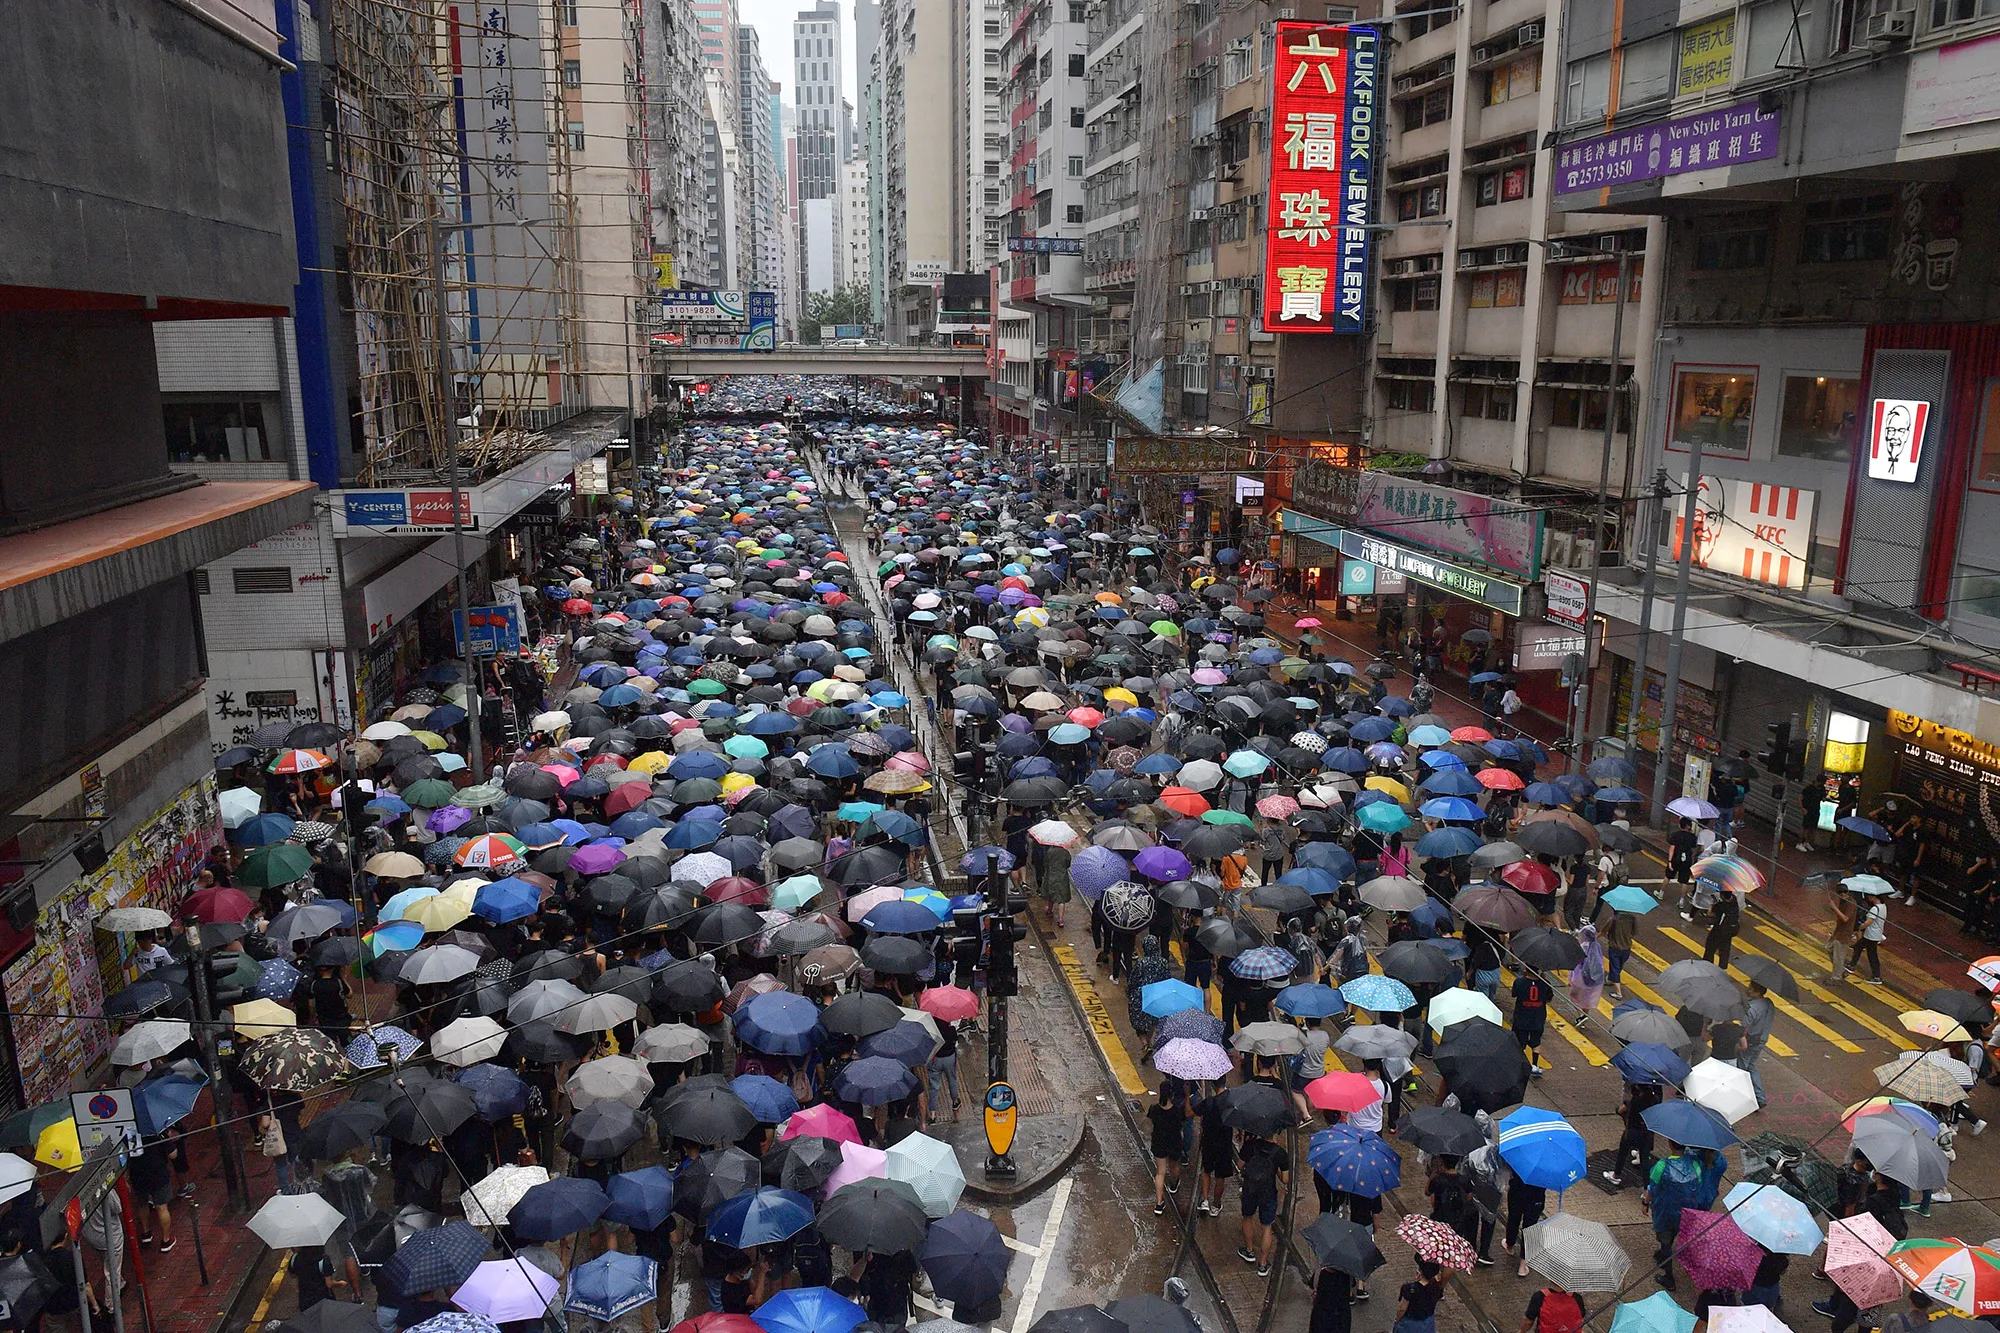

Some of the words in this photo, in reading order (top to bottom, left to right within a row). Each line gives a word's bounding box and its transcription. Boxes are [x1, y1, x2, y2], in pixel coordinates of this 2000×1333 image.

[1684, 22, 1735, 56] 東南大廈
[483, 8, 517, 211] 南洋商業銀行
[1350, 36, 1375, 160] LUKFOOK
[1669, 126, 1690, 141] New
[1693, 116, 1720, 136] Style
[1724, 112, 1751, 129] Yarn
[1669, 131, 1762, 169] 編織班招生
[1278, 34, 1340, 322] 六福珠寶
[1579, 167, 1604, 185] 2573
[1606, 159, 1632, 179] 9350
[1342, 168, 1367, 321] JEWELLERY
[349, 502, 403, 512] Y-CENTER
[519, 515, 553, 523] PARIS
[1754, 523, 1787, 545] KFC
[1361, 540, 1398, 569] 六福珠寶
[1534, 637, 1586, 652] 六福珠寶
[1905, 743, 1920, 756] LAO
[1925, 751, 1945, 765] FENG
[1949, 760, 1974, 776] XIANG
